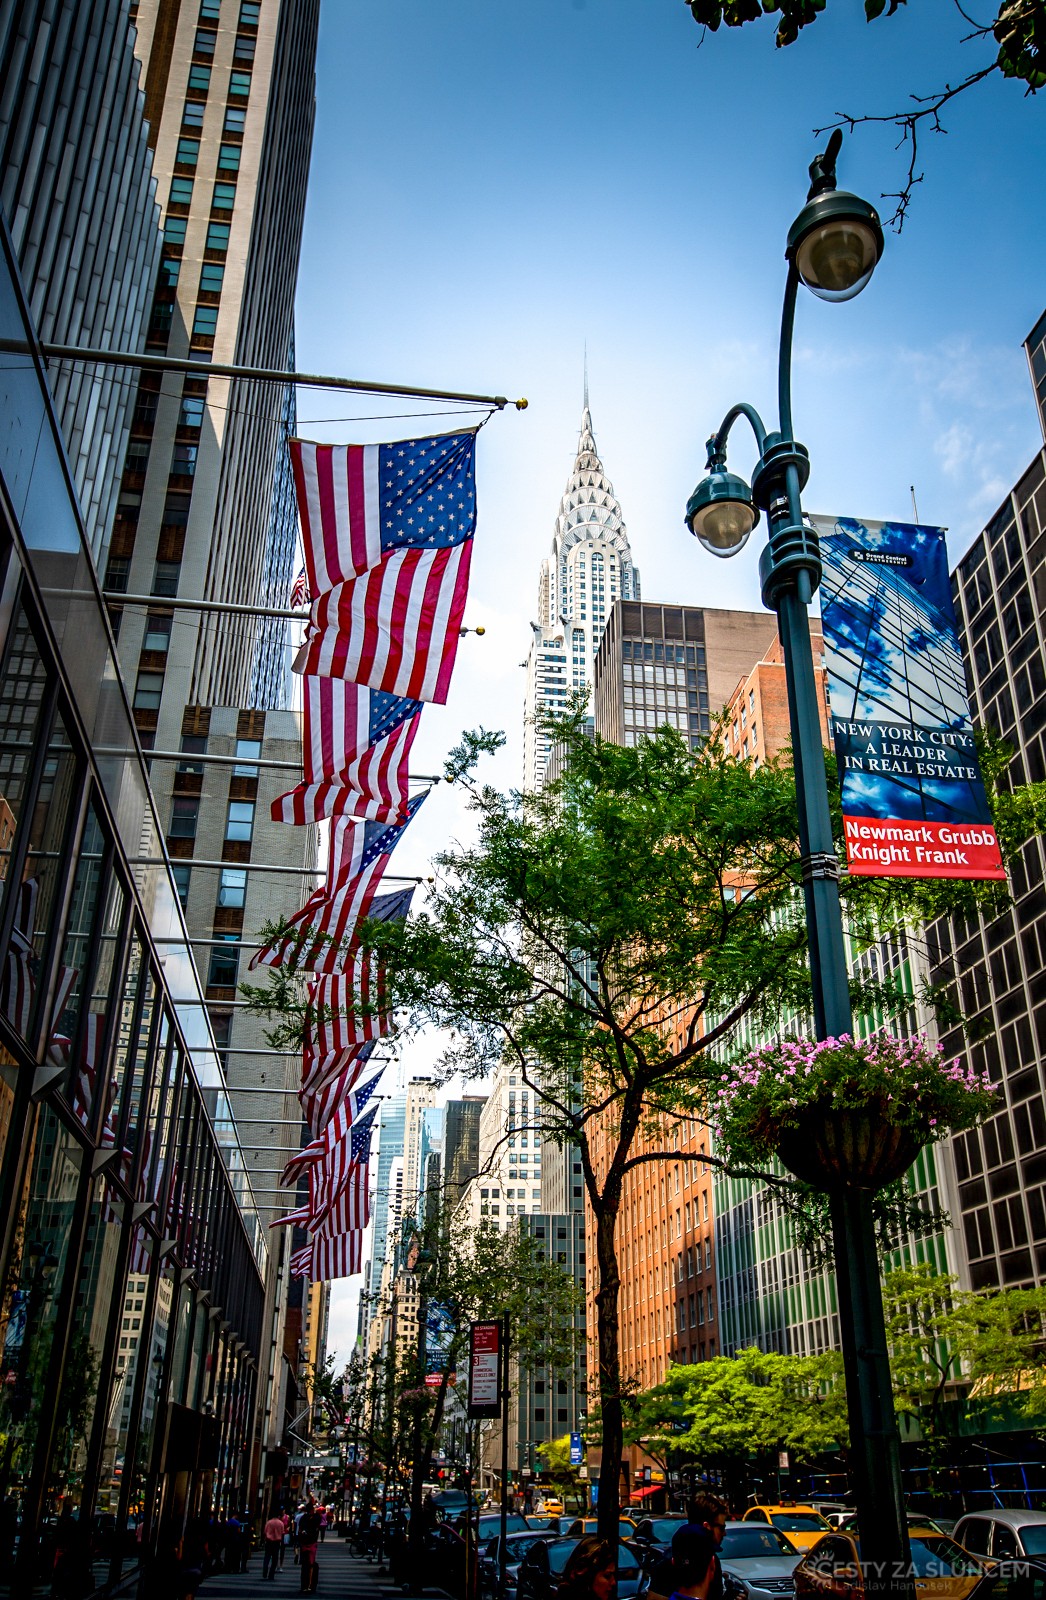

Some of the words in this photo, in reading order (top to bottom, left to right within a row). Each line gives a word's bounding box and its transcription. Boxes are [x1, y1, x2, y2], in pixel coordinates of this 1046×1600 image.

[865, 552, 884, 560] Grand
[866, 557, 907, 565] PARTNERSHIP
[835, 721, 873, 737] NEW
[877, 725, 926, 743] YORK
[929, 732, 973, 747] CITY:
[865, 742, 877, 755] A
[881, 742, 949, 762] LEADER
[844, 755, 863, 769] IN
[867, 758, 913, 774] REAL
[916, 762, 977, 780] ESTATE
[845, 821, 935, 843] Newmark
[938, 827, 995, 846] Grubb
[848, 842, 912, 865] Knight
[915, 846, 969, 865] Frank
[473, 1357, 479, 1366] 3
